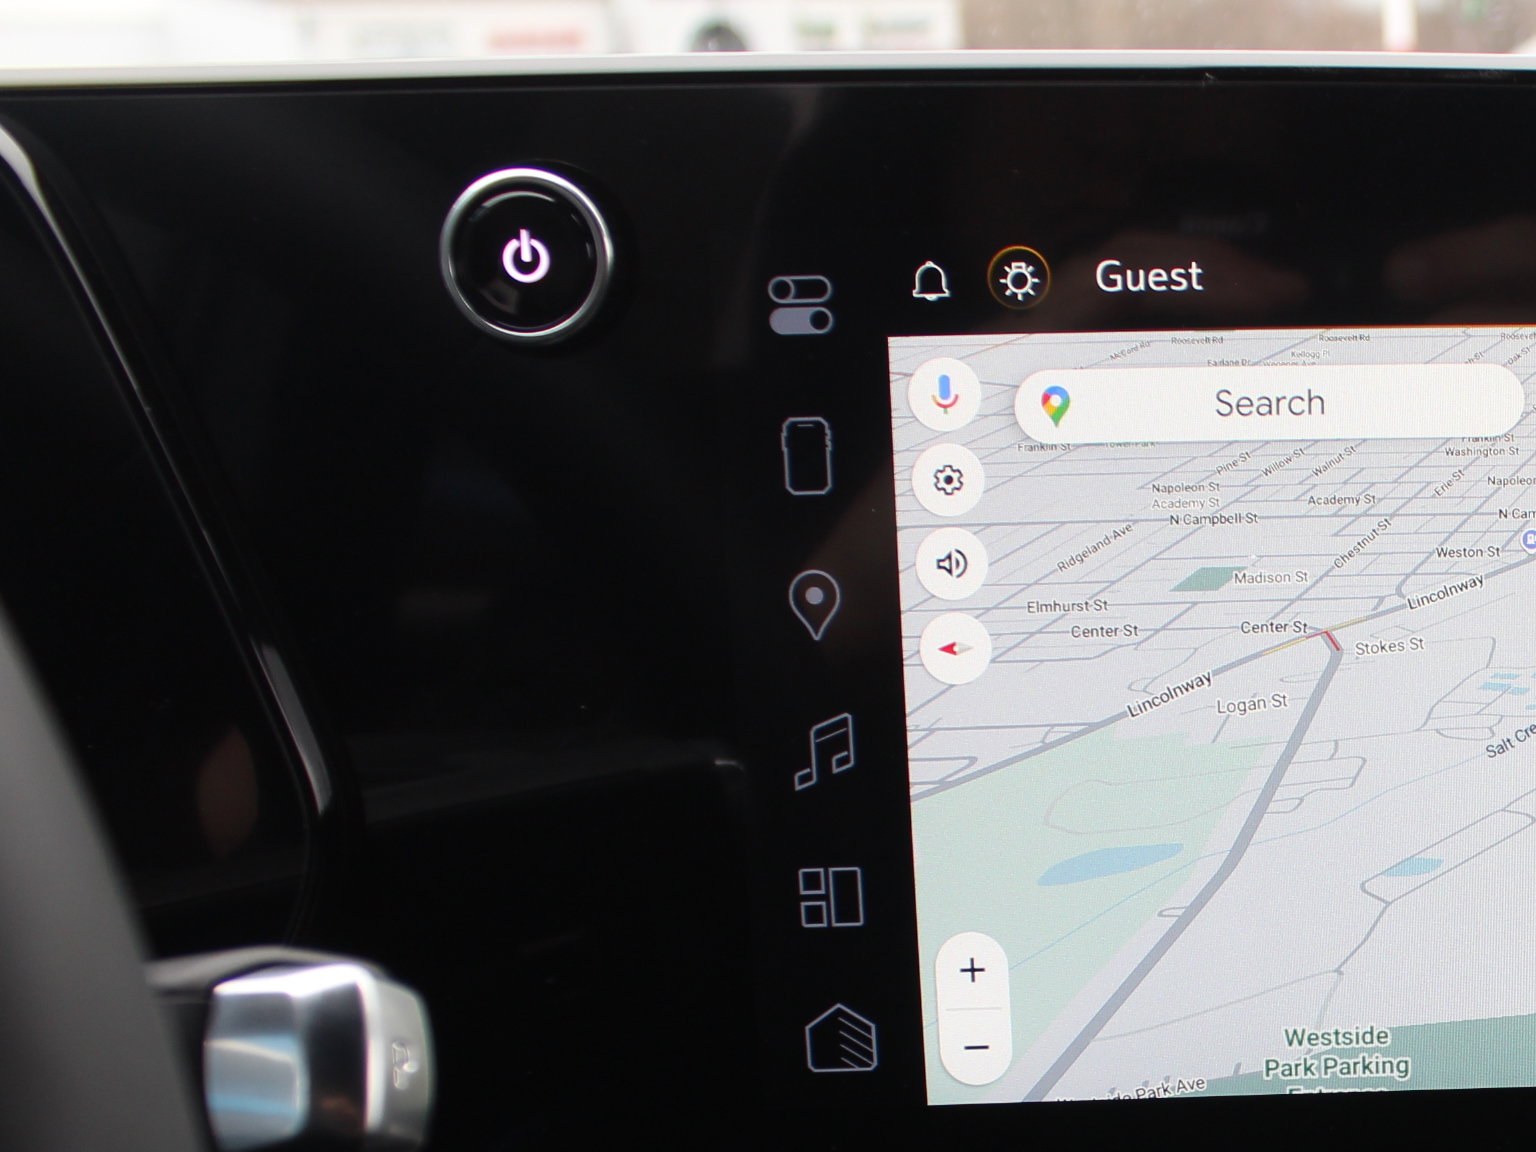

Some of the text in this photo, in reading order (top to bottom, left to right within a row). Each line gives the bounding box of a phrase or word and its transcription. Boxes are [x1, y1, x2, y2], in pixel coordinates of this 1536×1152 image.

[1096, 259, 1204, 292] Guest
[1171, 336, 1224, 345] Roosevelt Rd
[1318, 334, 1370, 342] Roosevelt Rd
[1215, 389, 1326, 418] Search
[1018, 442, 1072, 451] Franklin St
[1445, 446, 1520, 458] Washington St
[1215, 450, 1252, 475] Pine St
[1261, 447, 1305, 477] Willow St
[1312, 445, 1357, 478] Walnut St
[1151, 482, 1220, 494] Napoleon St
[1433, 468, 1466, 497] Erie St
[1151, 497, 1220, 511] Academy St
[1307, 494, 1376, 507] Academy St
[1169, 513, 1259, 527] N Campbell St
[1498, 508, 1508, 519] N
[1056, 523, 1134, 573] Ridgeland Ave
[1333, 517, 1392, 570] Chestnut St
[1436, 546, 1501, 558] Weston St
[1234, 571, 1308, 585] Madison St
[1407, 573, 1485, 610] Lincolnway
[1027, 599, 1109, 614] Elmhurst St
[1071, 624, 1139, 638] Center St
[1240, 620, 1308, 634] Center St
[1355, 638, 1425, 656] Stokes St
[1126, 670, 1214, 718] Lincolnway
[1216, 693, 1288, 716] Logan St
[1485, 738, 1516, 759] Salt
[1284, 1026, 1389, 1048] Westside
[1265, 1055, 1409, 1079] Park Parking
[1135, 1082, 1171, 1100] Park
[1176, 1078, 1206, 1094] Ave
